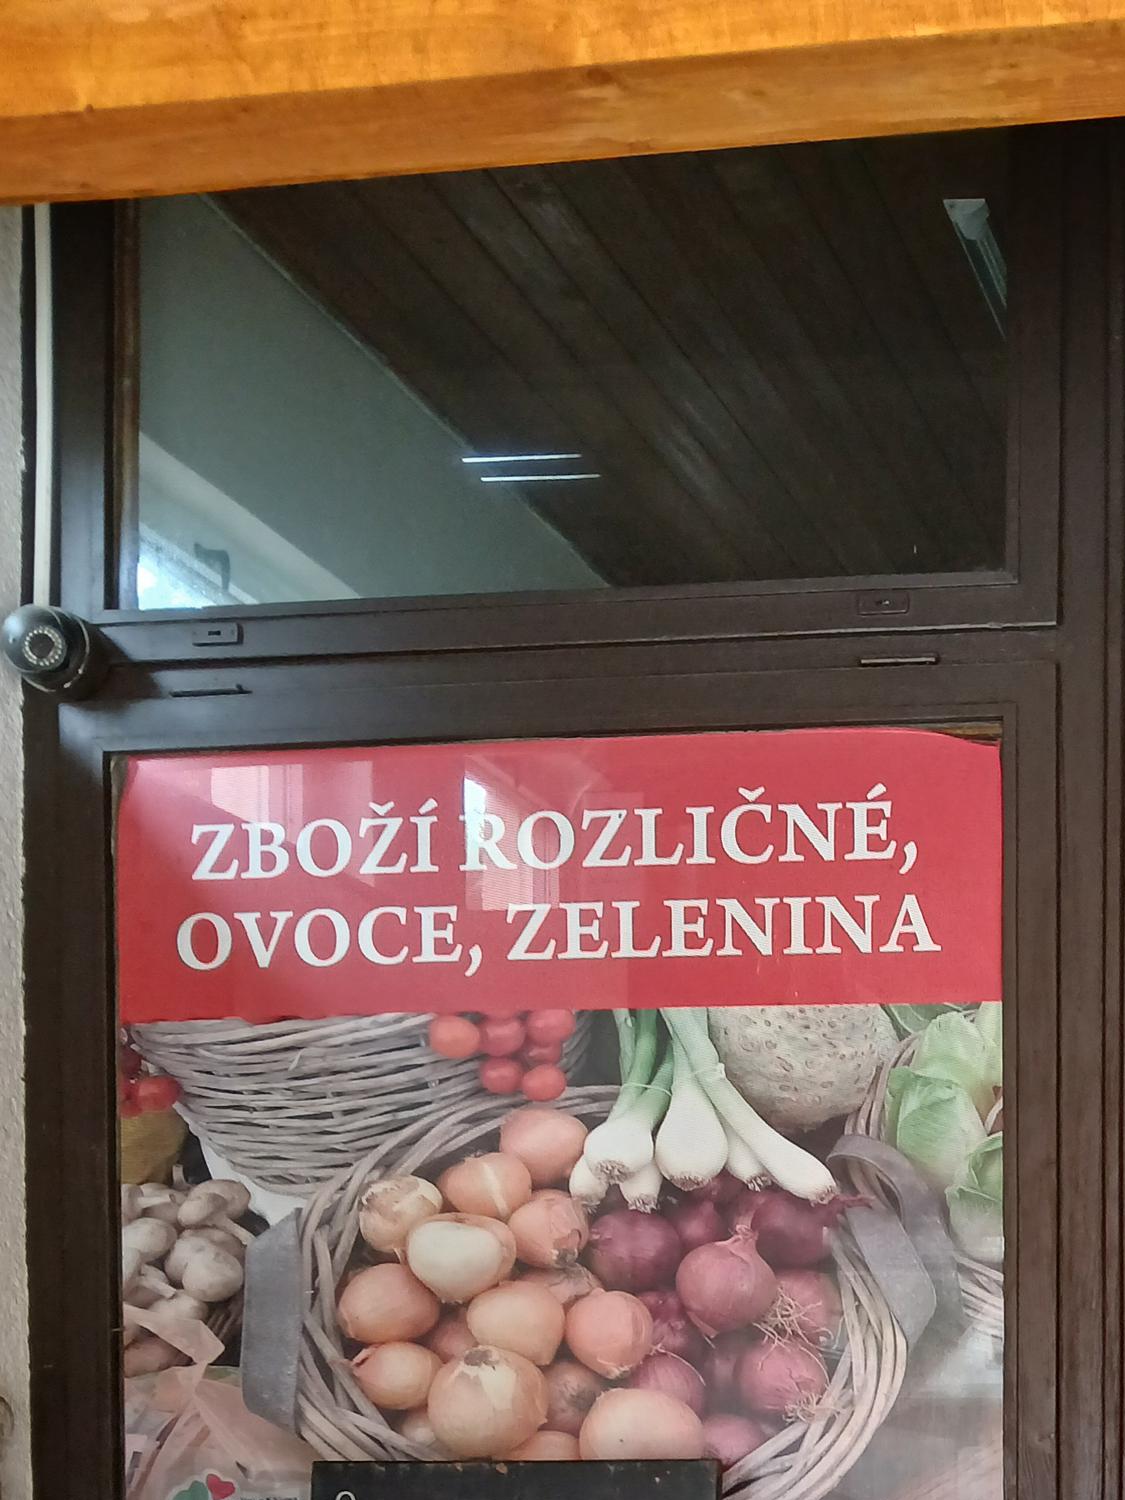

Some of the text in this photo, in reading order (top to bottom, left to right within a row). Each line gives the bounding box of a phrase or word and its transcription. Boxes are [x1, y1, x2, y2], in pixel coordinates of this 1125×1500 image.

[190, 784, 920, 881] ZBOŽÍ ROZLIČNÉ,
[175, 892, 942, 977] OVOCE, ZELENINA
